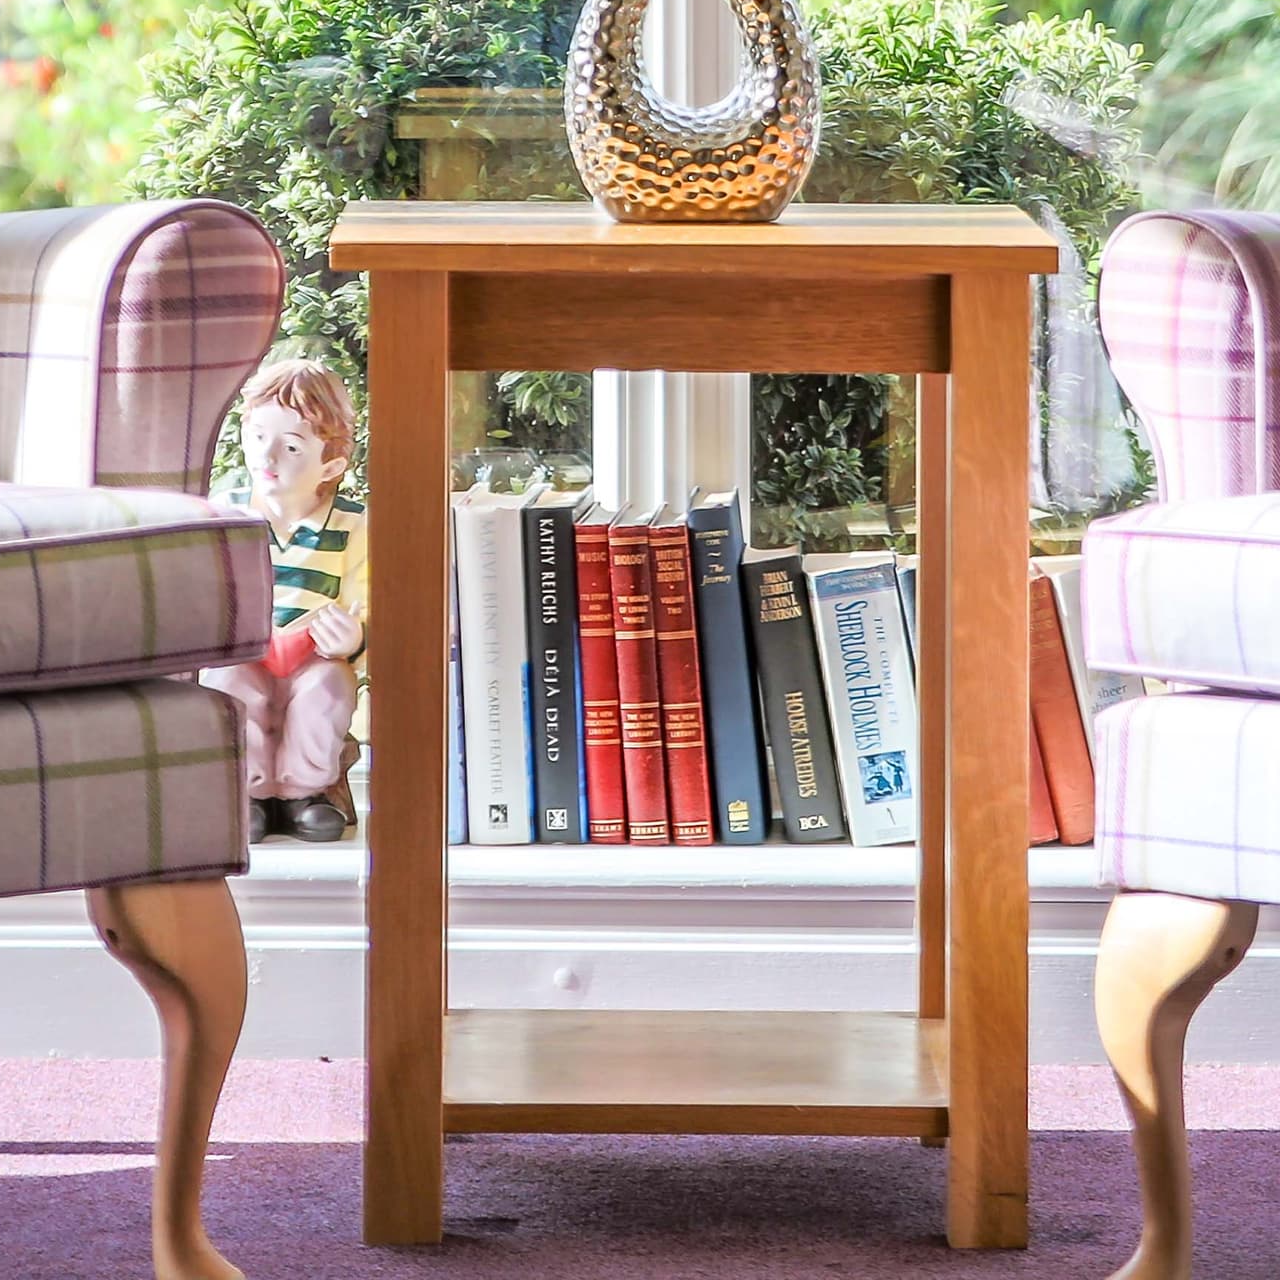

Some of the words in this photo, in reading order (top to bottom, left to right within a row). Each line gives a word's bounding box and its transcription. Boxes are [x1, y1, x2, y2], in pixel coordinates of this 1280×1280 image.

[479, 518, 500, 583] MAEVE
[539, 517, 556, 566] KATHY
[578, 552, 607, 563] MUSIC
[613, 553, 647, 566] BIOLOGY
[658, 560, 684, 571] SOCIAL
[541, 571, 558, 625] REICHS
[762, 570, 788, 584] BRIAN
[760, 605, 802, 623] ANDERSON
[873, 618, 886, 641] THE
[834, 600, 872, 683] SHERLOCK
[487, 679, 502, 734] SCARLET
[784, 690, 809, 737] HOUSE
[847, 684, 883, 751] HOLMES
[545, 707, 561, 763] DEAD
[488, 738, 504, 795] FEATHER
[792, 737, 817, 799] ATREIDES
[798, 815, 829, 830] BCA
